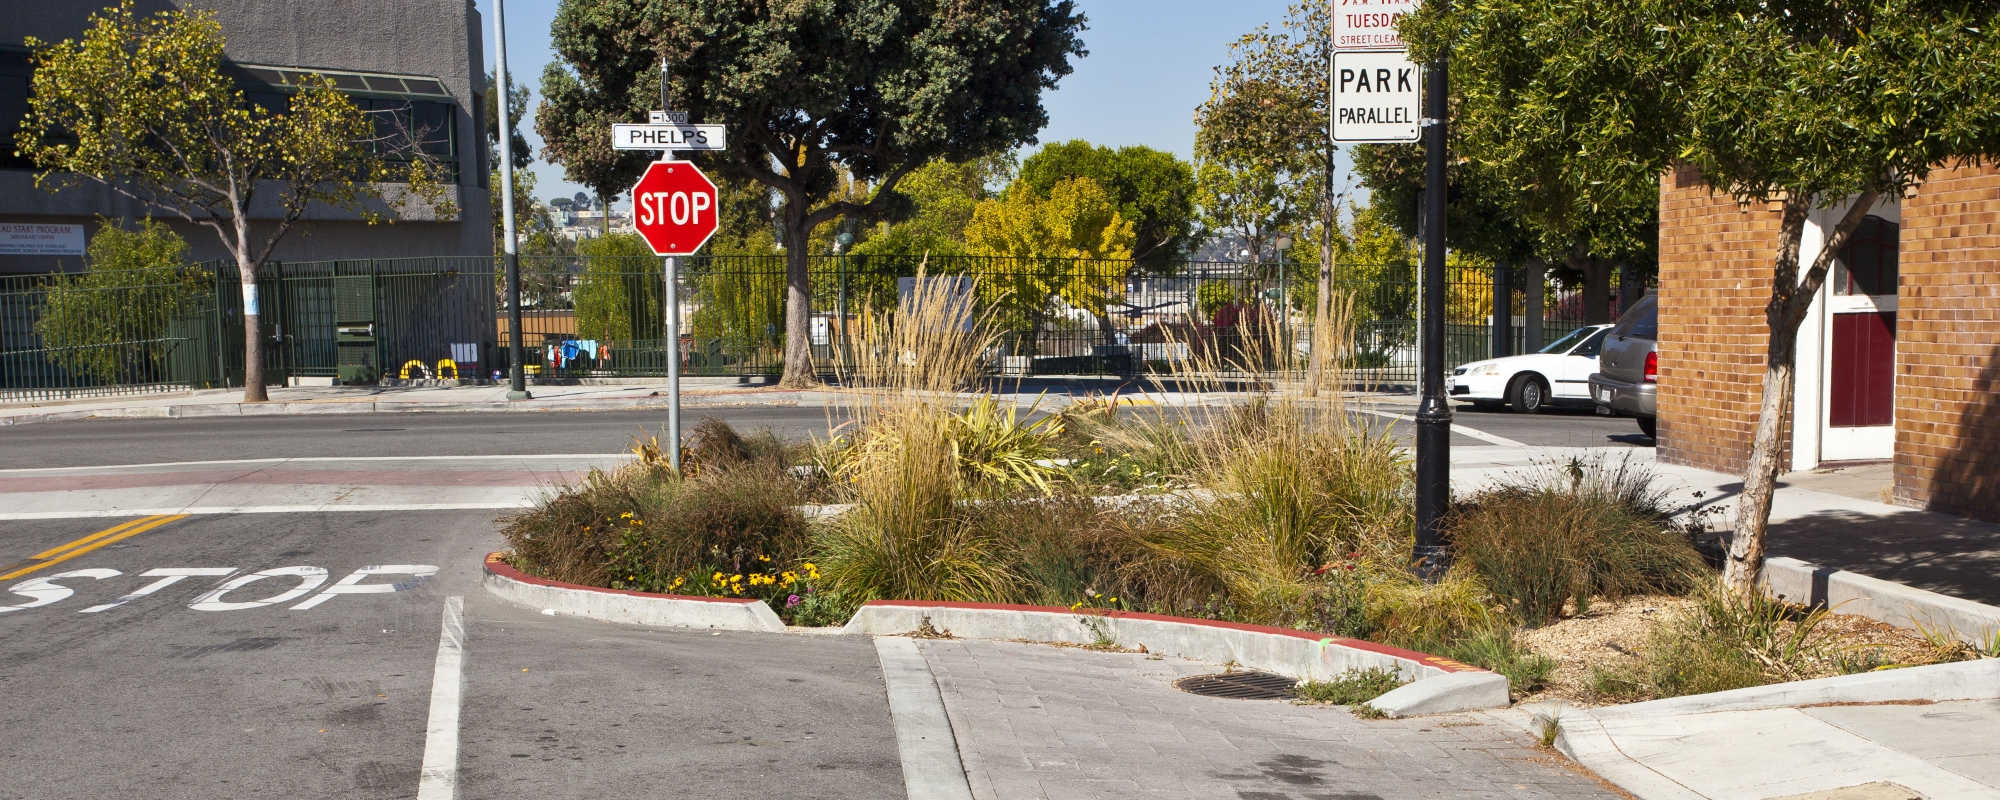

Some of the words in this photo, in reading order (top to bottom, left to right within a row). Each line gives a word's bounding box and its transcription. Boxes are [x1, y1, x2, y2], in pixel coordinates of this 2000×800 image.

[1346, 13, 1405, 28] TUESDA
[1340, 35, 1371, 44] STREET
[1373, 34, 1404, 44] CLEAN
[1340, 68, 1412, 93] PARK
[661, 113, 685, 123] 1300
[1339, 107, 1413, 124] PARALLEL
[630, 130, 708, 144] PHELPS
[640, 191, 711, 226] STOP
[36, 226, 71, 234] PROGRAM
[0, 565, 440, 613] STOP
